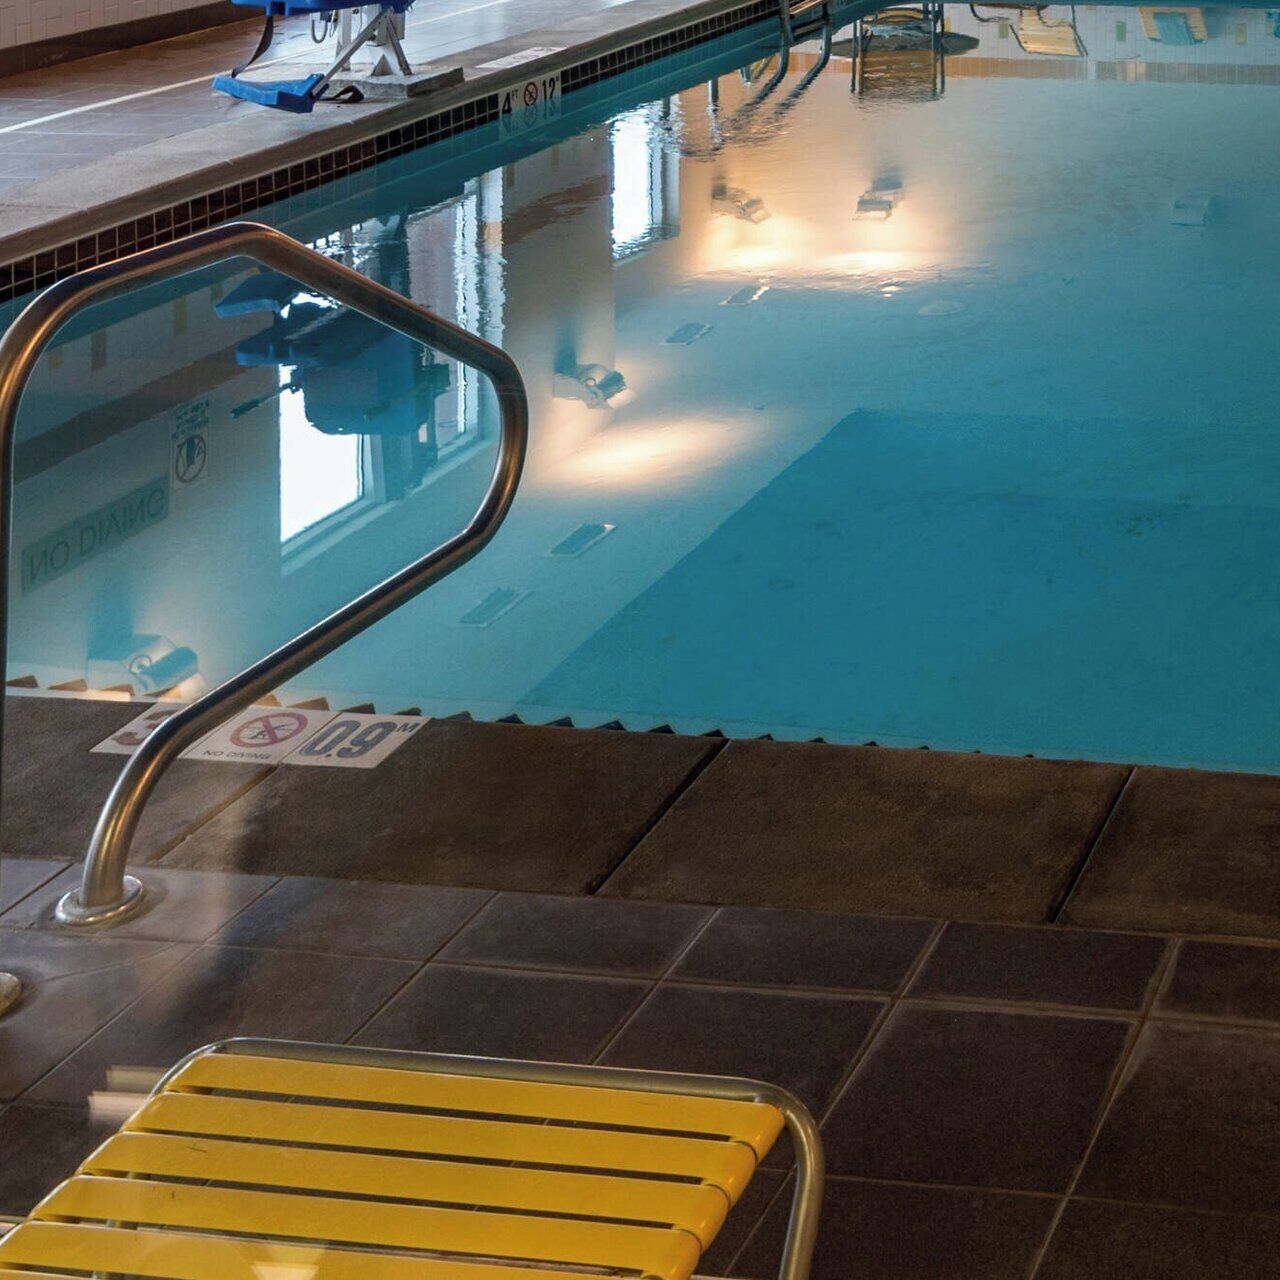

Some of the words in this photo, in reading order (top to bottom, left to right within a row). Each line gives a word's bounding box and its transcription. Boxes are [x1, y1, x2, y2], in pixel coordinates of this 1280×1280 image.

[502, 92, 513, 115] 4
[299, 719, 397, 758] 0.9
[226, 751, 272, 760] DIVING
